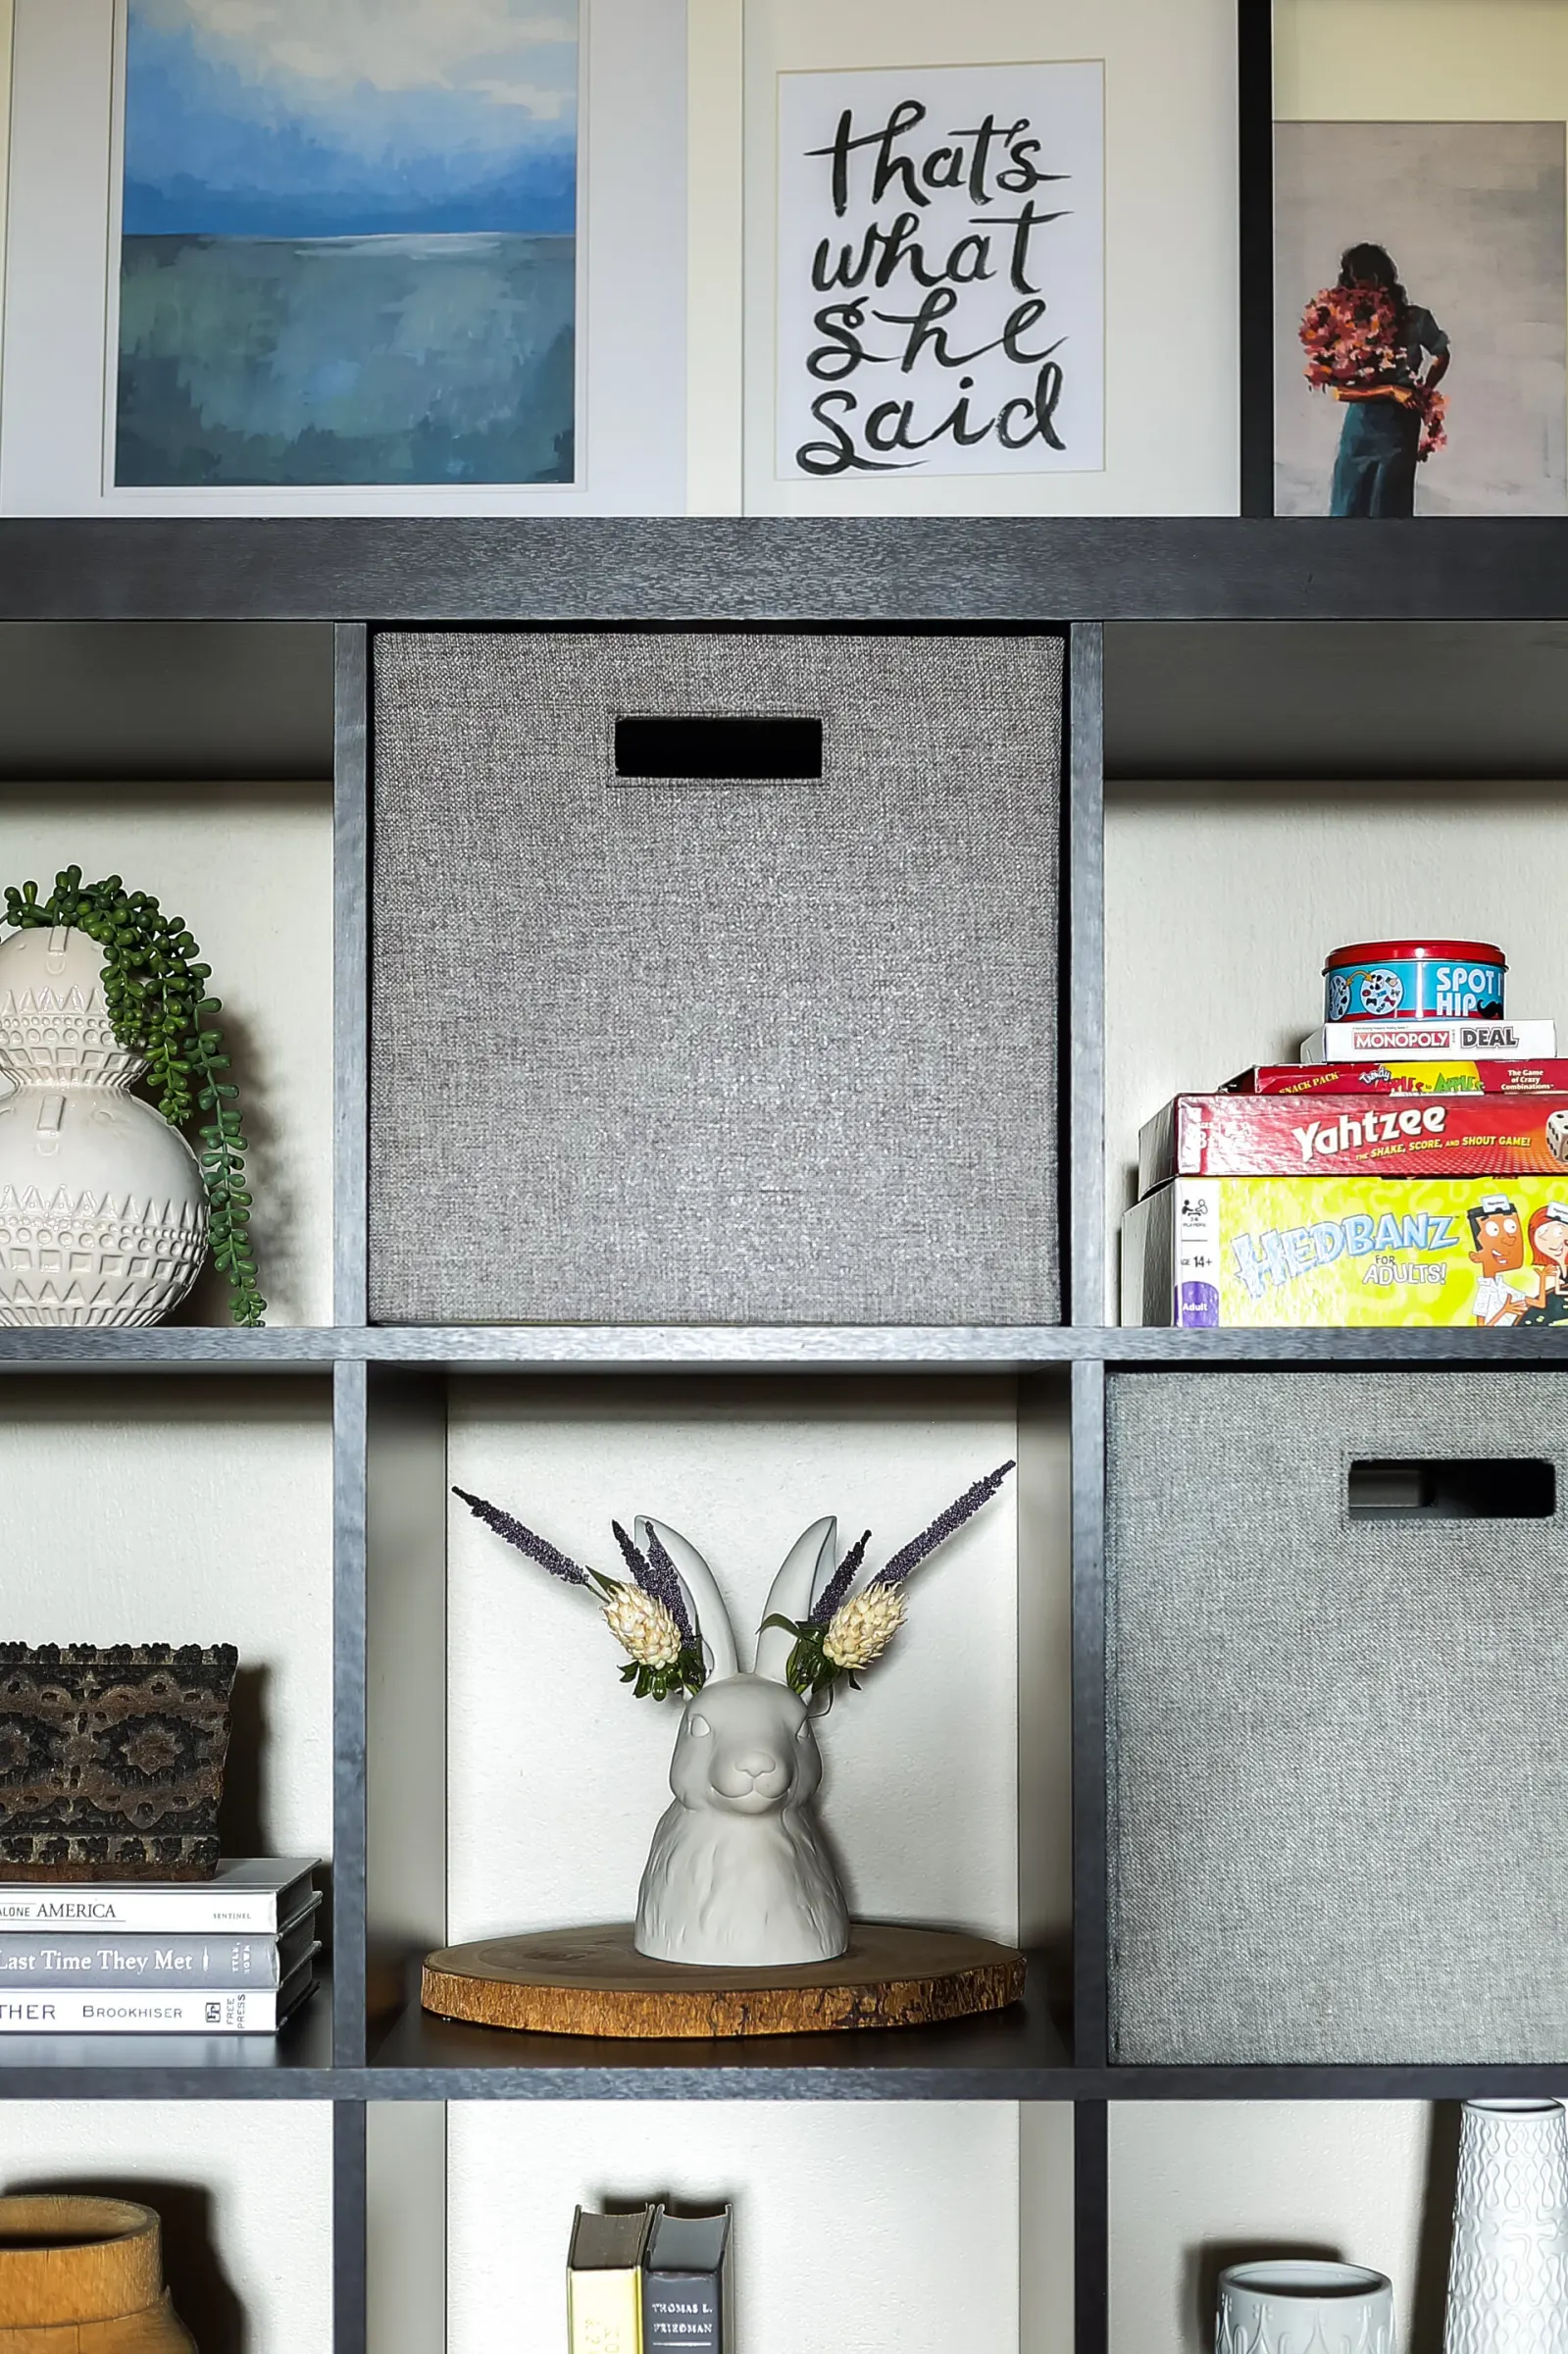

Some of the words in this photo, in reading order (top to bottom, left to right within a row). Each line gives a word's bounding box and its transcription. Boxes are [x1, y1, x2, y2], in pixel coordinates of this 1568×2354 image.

[803, 99, 1072, 218] that's
[811, 200, 1074, 294] what
[806, 286, 1069, 381] she
[796, 362, 1066, 476] said
[1437, 967, 1494, 995] SPOT
[1437, 992, 1477, 1017] HIP
[1355, 1032, 1448, 1049] MONOPOLY
[1460, 1027, 1519, 1049] DEAL
[1313, 1071, 1340, 1086] PACK
[1520, 1076, 1541, 1085] Crazy
[1291, 1104, 1448, 1163] Yahtzee
[1370, 1144, 1406, 1158] SHAKE,
[1409, 1139, 1443, 1151] SCORE,
[1462, 1136, 1495, 1147] SHOUT
[1498, 1136, 1532, 1148] GAME!
[1193, 1255, 1213, 1268] 14+
[1230, 1212, 1460, 1301] HEDBANZ
[1375, 1254, 1395, 1265] FOR
[1362, 1262, 1447, 1286] ADULTS!
[1182, 1303, 1208, 1312] Adult
[0, 1906, 30, 1918] LONE
[36, 1903, 117, 1919] AMERICA
[40, 1948, 92, 1970] Time
[96, 1948, 149, 1975] They
[154, 1949, 193, 1970] Met
[227, 1998, 235, 2025] FREE
[237, 1993, 246, 2029] PRESS
[652, 2303, 699, 2314] THOMAS
[653, 2323, 713, 2334] FRIEDMAN
